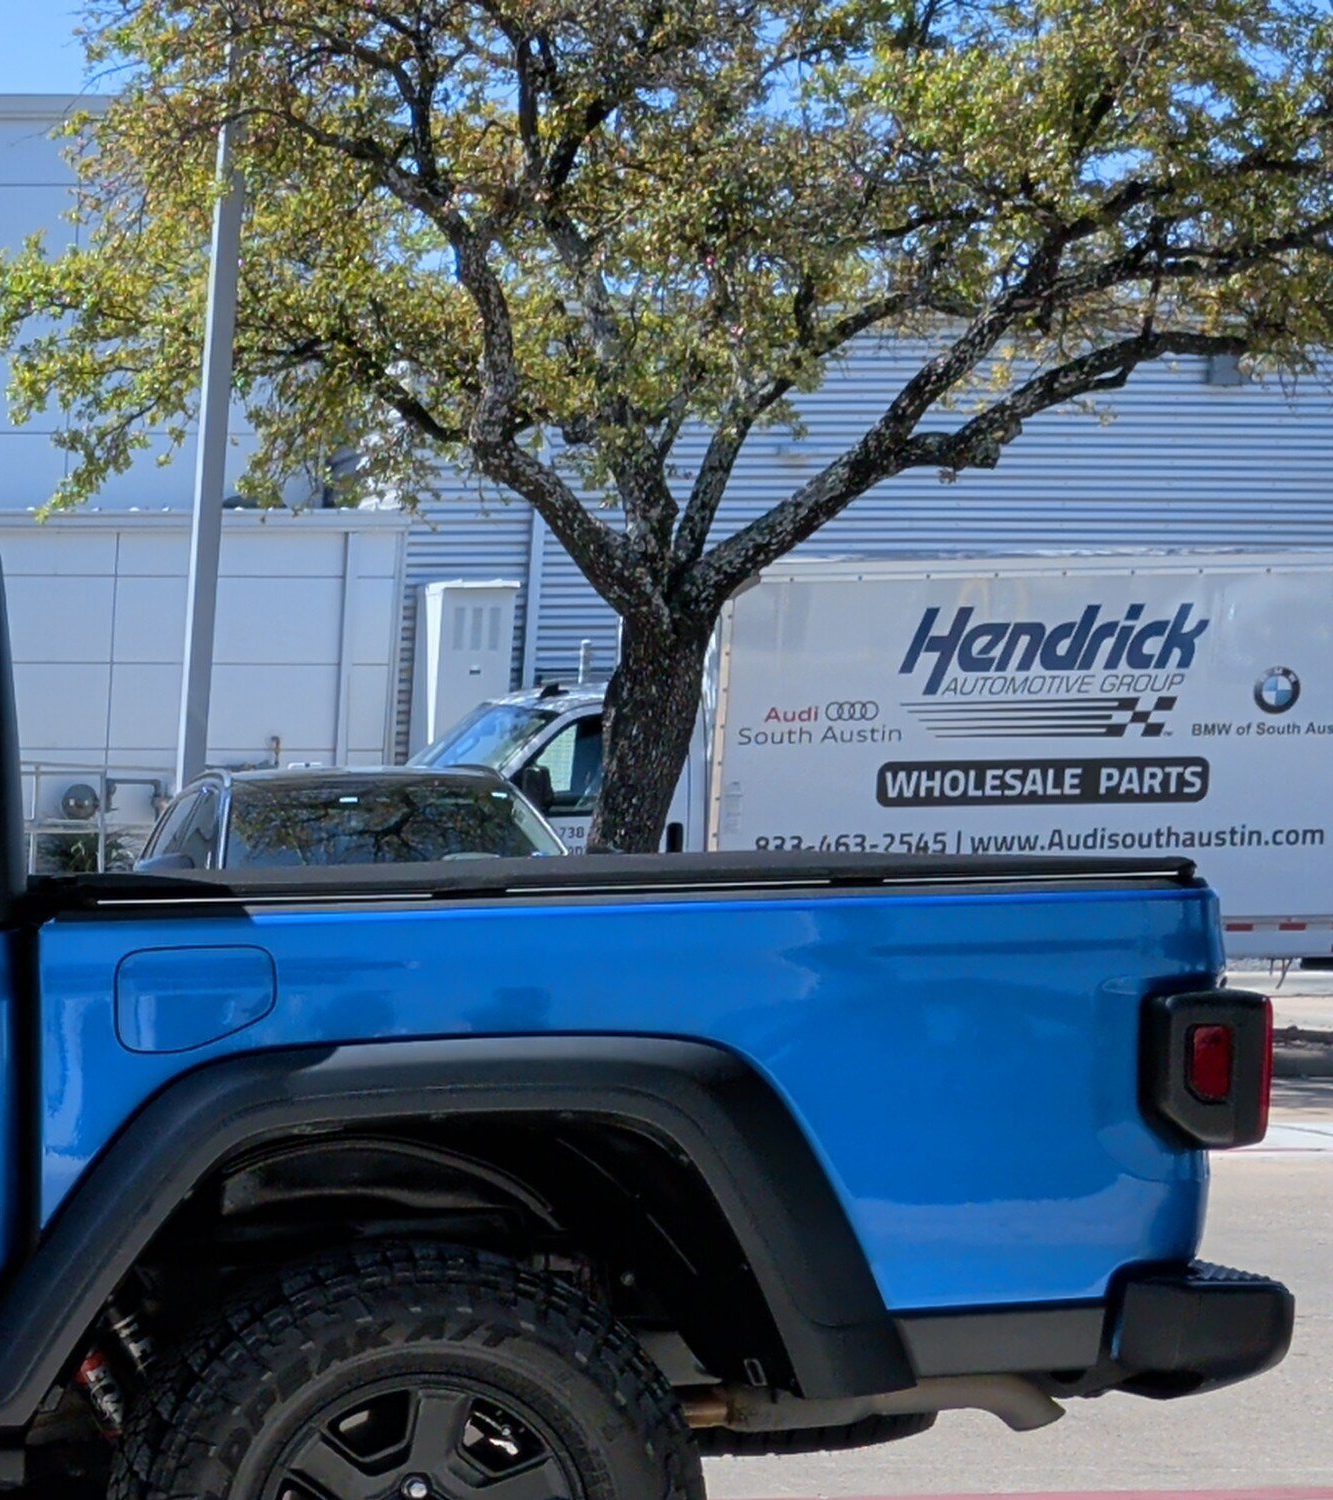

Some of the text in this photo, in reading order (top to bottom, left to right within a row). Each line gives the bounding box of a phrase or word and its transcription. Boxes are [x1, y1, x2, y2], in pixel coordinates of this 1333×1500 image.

[898, 602, 1210, 695] Hendrick
[941, 673, 1186, 696] AUTOMOTIVE GROUP
[764, 706, 819, 723] Audi
[738, 724, 902, 745] South Austin
[1191, 723, 1232, 736] BMW
[1236, 722, 1252, 735] of
[1256, 722, 1301, 735] South
[885, 766, 1202, 798] WHOLESALE PARTS
[970, 824, 1325, 853] www.Audisouthaustin.com
